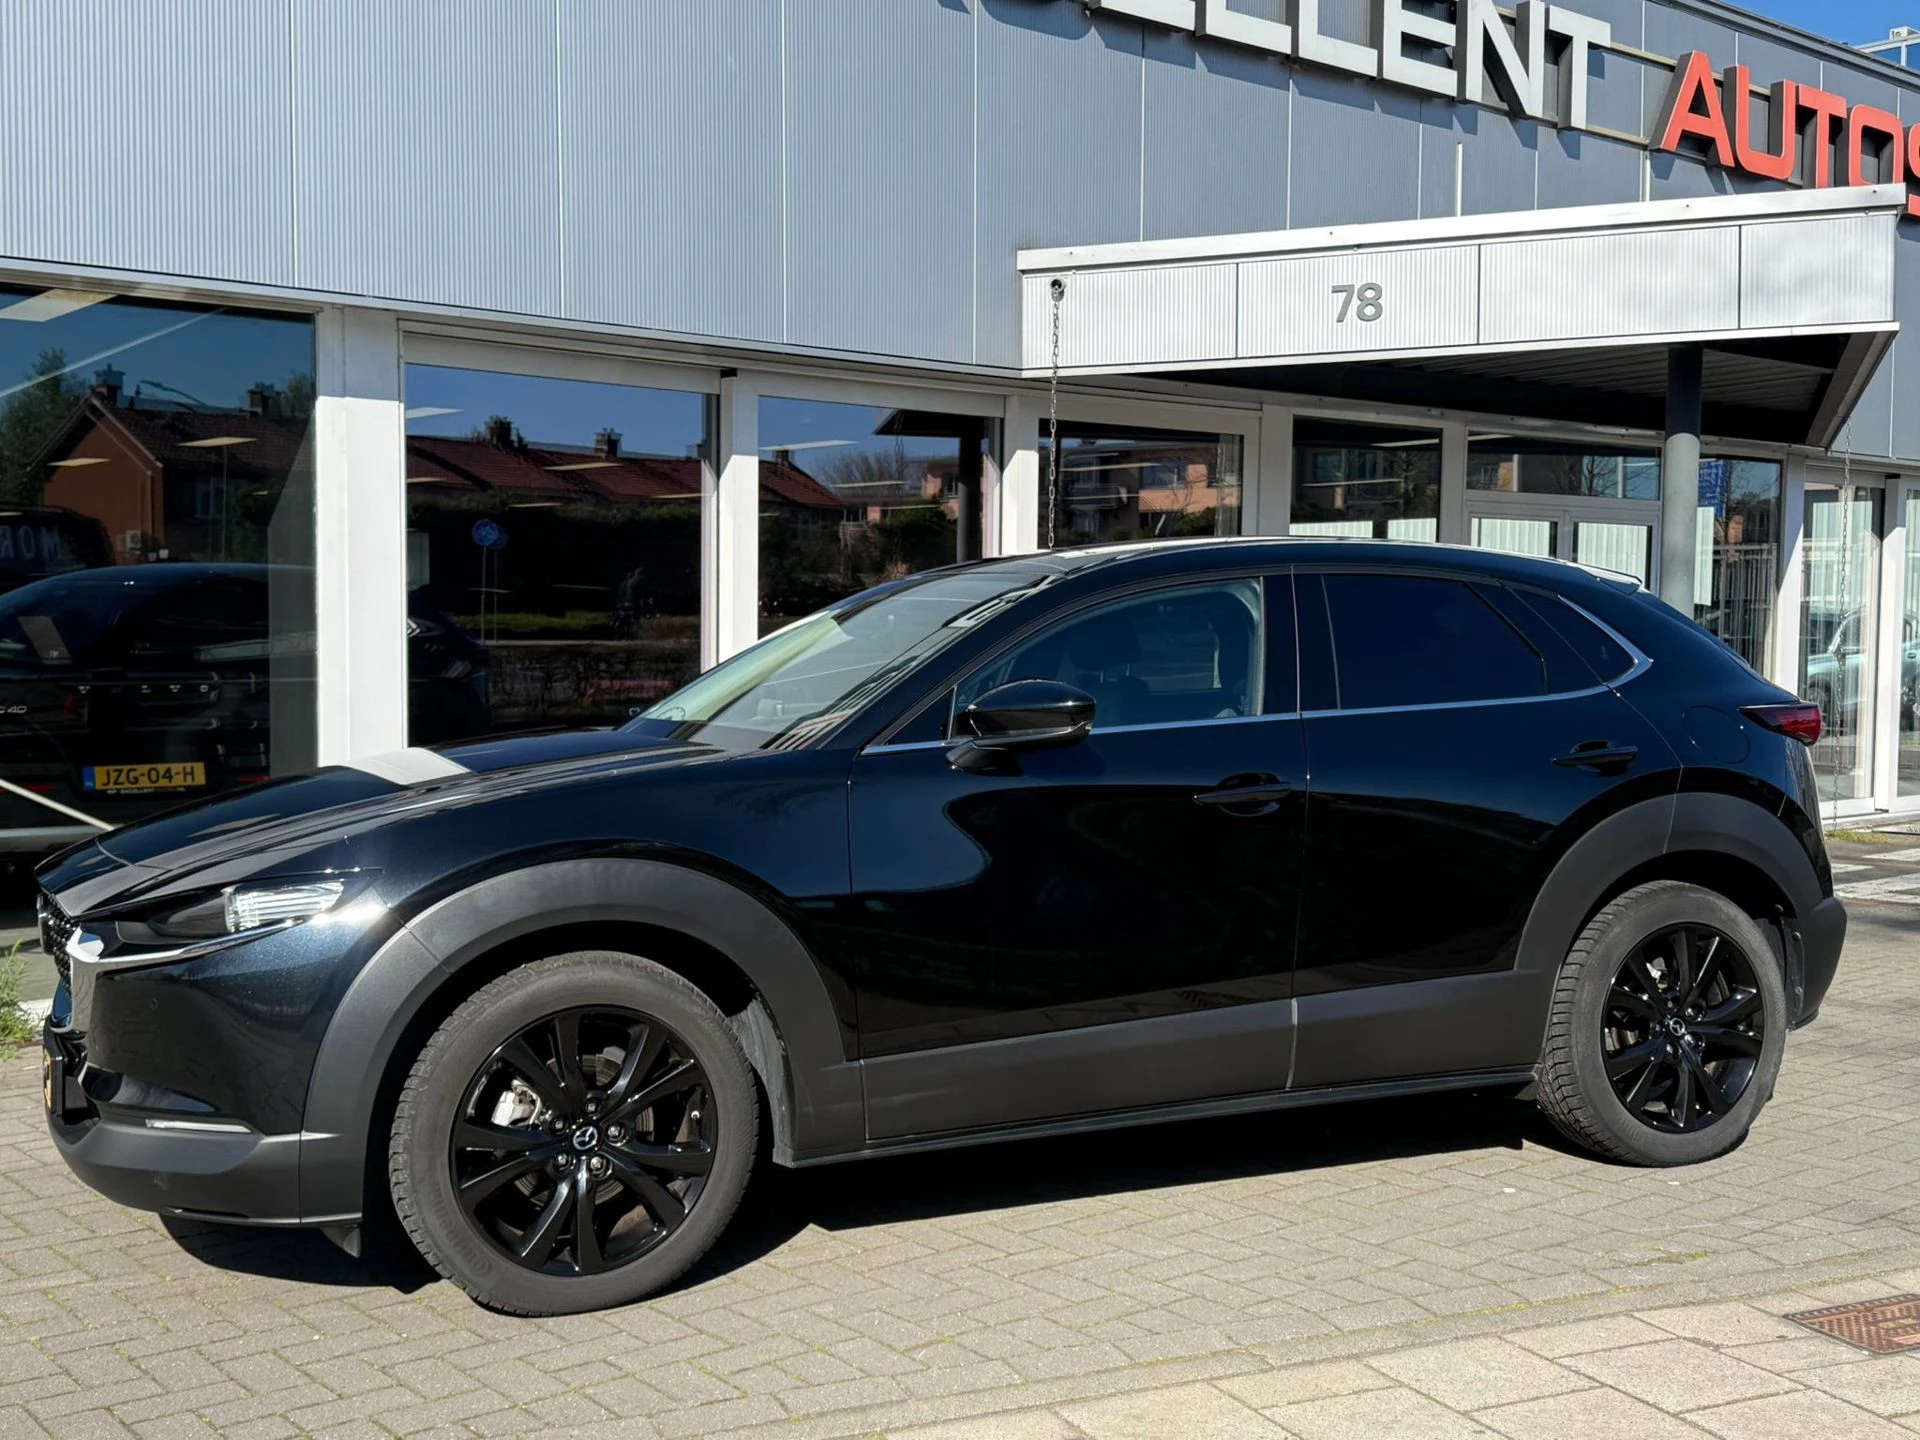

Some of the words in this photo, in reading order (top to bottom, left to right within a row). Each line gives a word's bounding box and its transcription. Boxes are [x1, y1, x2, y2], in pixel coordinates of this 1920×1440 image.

[1660, 50, 1920, 218] AUTO
[1331, 282, 1383, 323] 78
[101, 765, 195, 787] JZG-04-H
